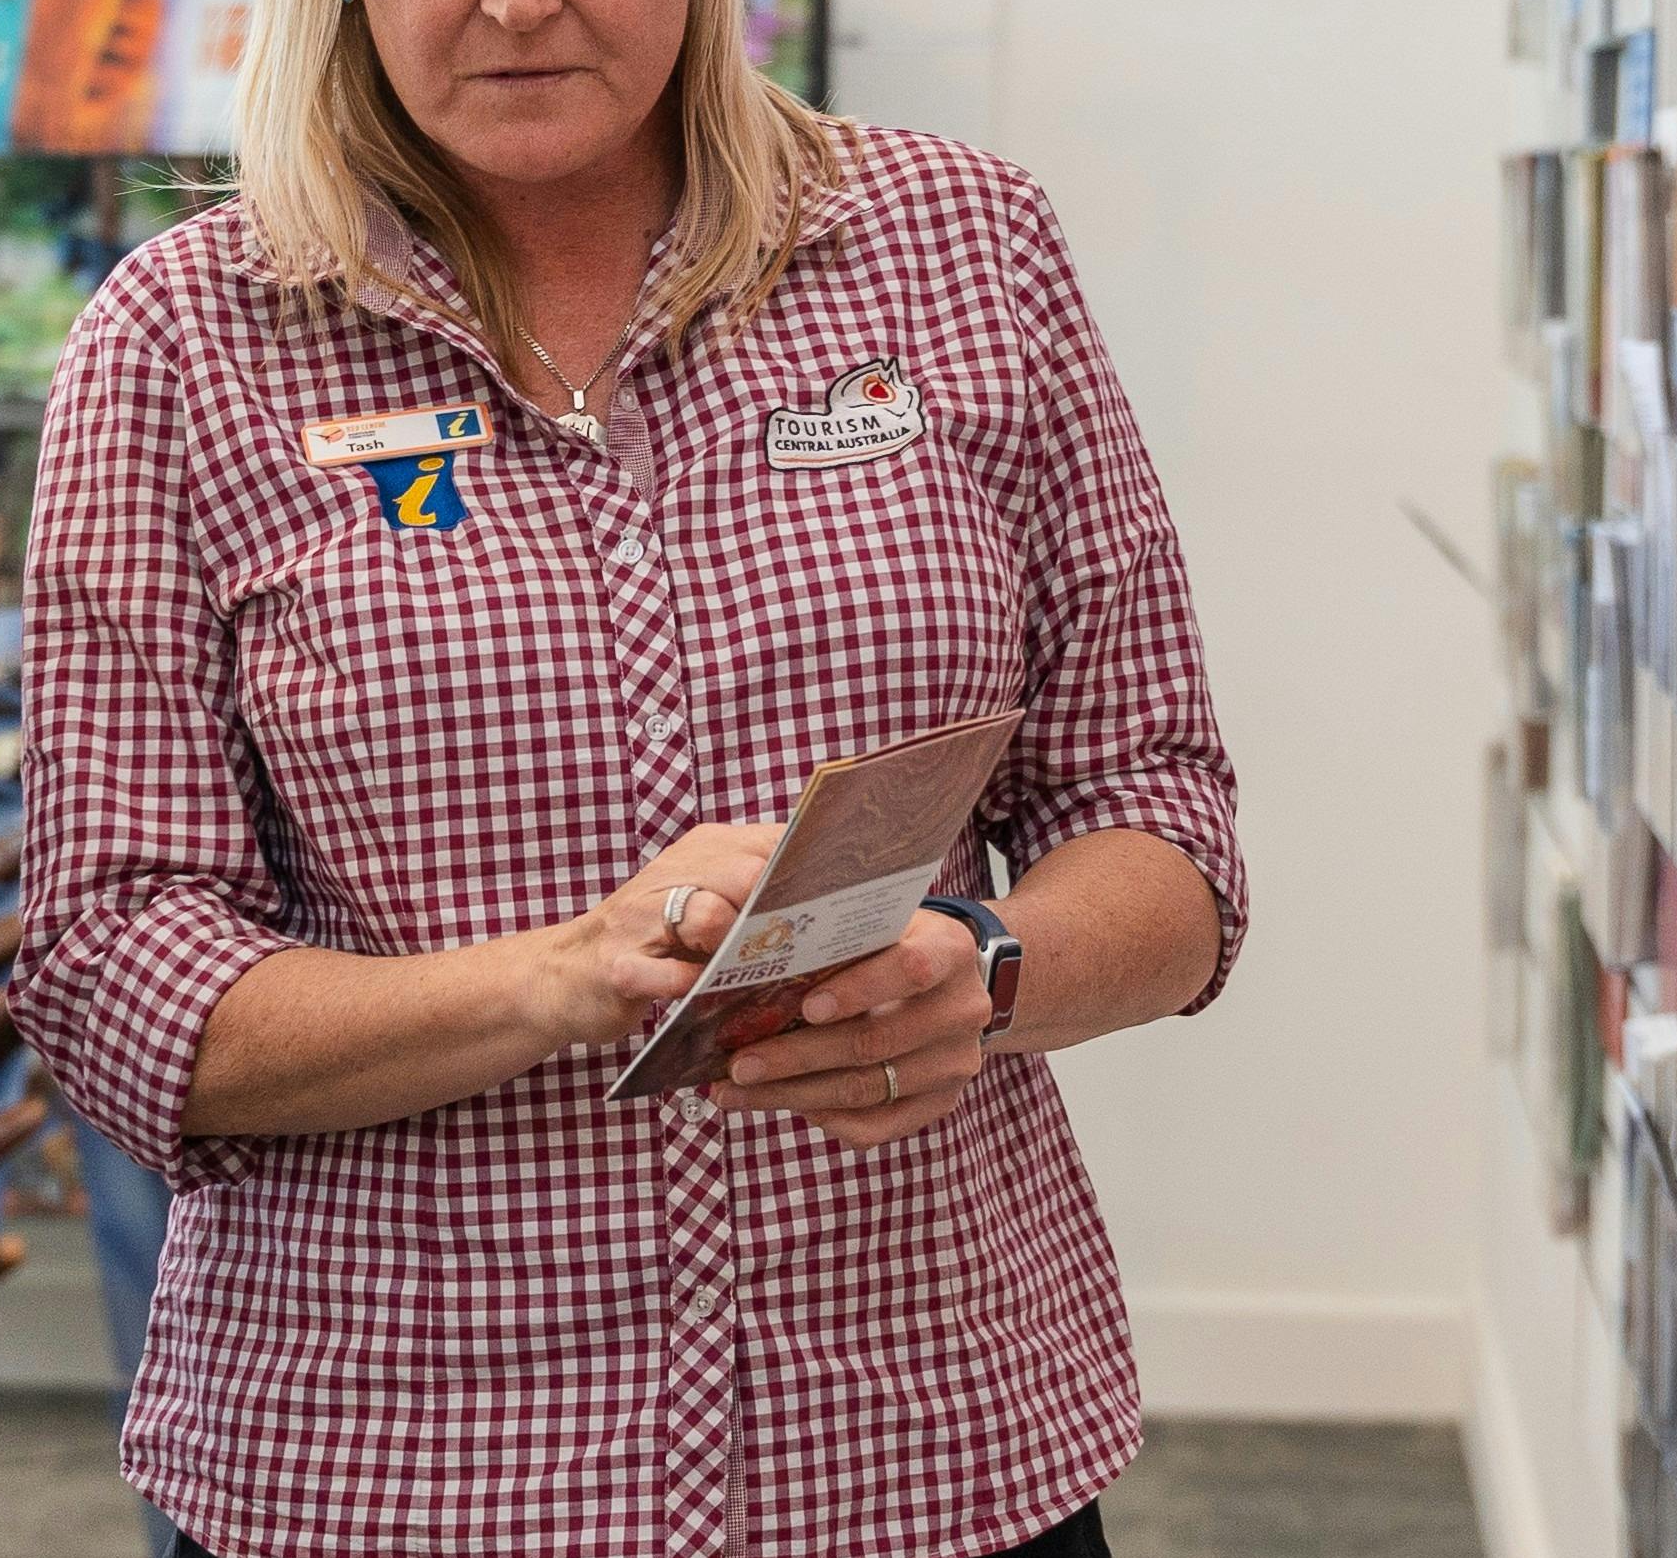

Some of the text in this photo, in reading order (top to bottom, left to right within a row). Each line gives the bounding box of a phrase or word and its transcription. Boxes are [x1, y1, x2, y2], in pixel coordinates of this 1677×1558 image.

[775, 415, 882, 437] TOURISM
[346, 439, 385, 453] Tash
[775, 426, 911, 452] CENTRAL AUSTRALIA
[708, 962, 789, 988] ARTISTS
